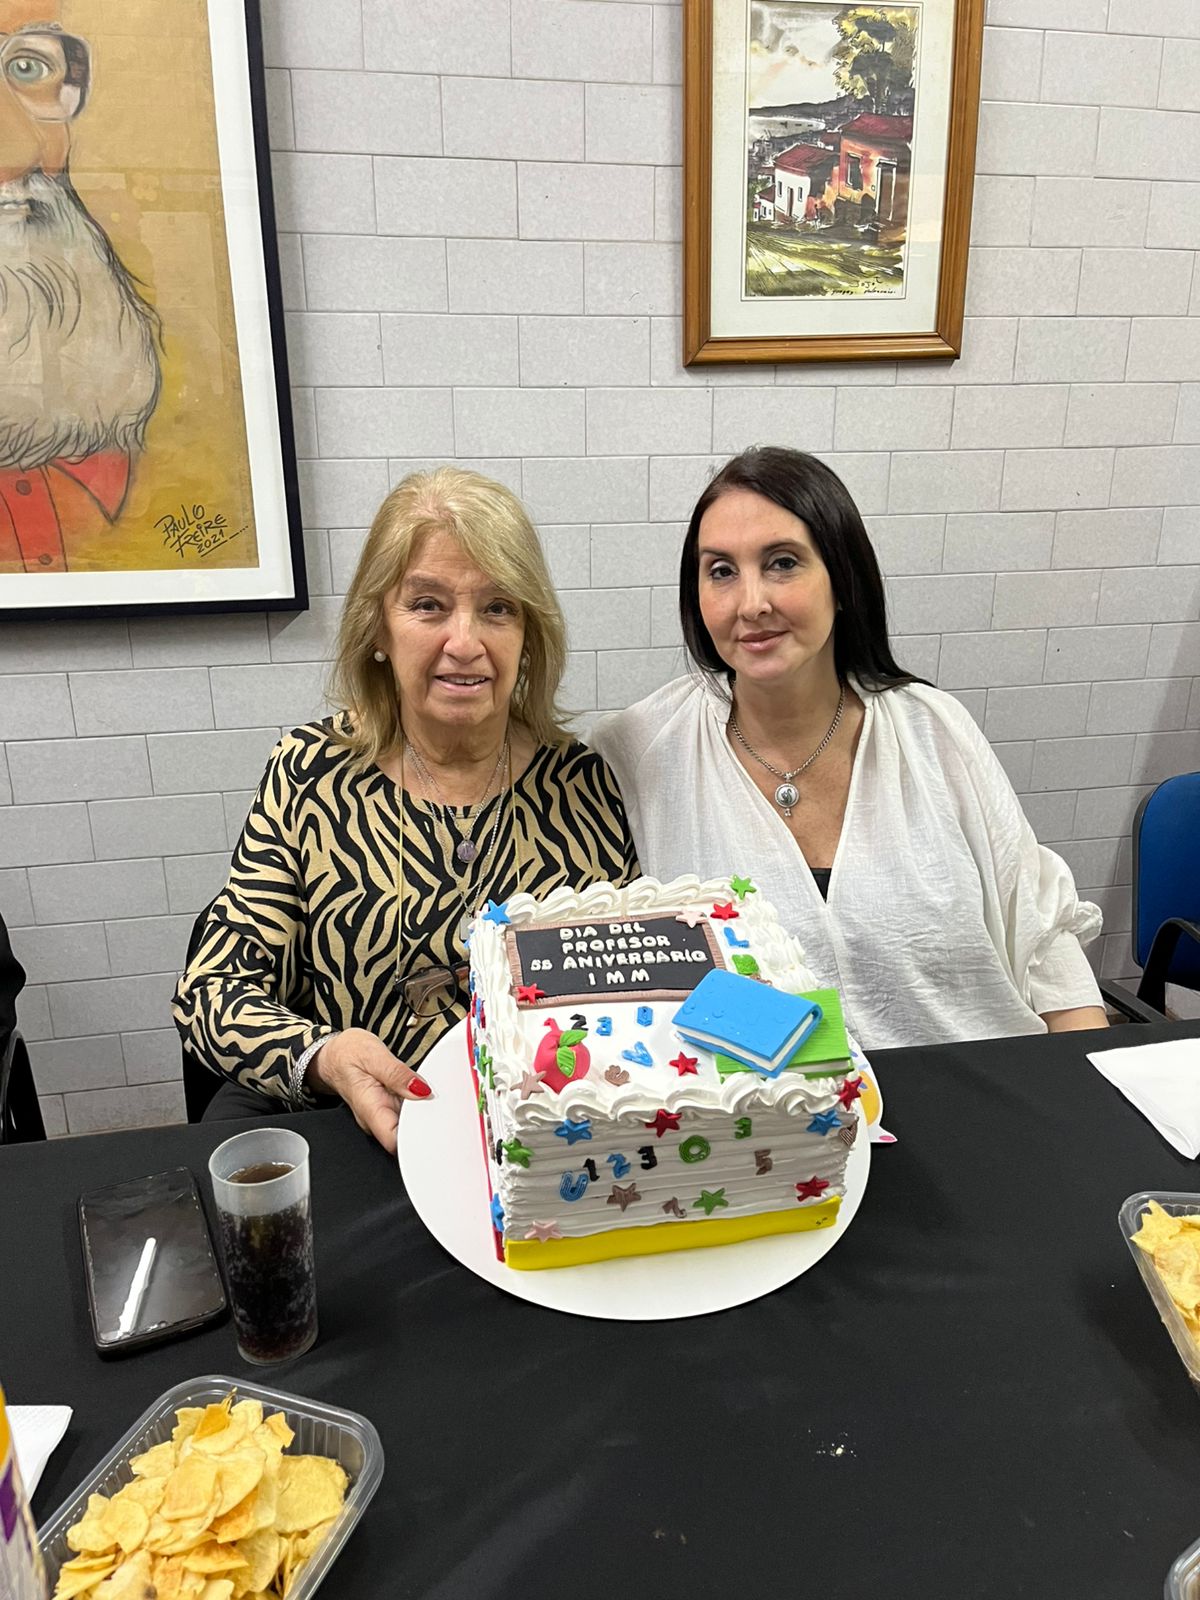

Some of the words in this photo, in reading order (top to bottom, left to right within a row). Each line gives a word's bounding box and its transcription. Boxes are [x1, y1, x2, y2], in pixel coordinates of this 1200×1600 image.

[153, 504, 206, 545] PAULO
[169, 513, 228, 558] FREIRE
[196, 528, 225, 554] 2021
[559, 925, 598, 941] DIA
[608, 921, 646, 935] DEL
[561, 935, 671, 954] PROFESOR
[562, 949, 708, 970] ANIVERSARIO
[582, 1157, 600, 1182] 1
[636, 1145, 658, 1170] 3
[753, 1148, 773, 1176] 5
